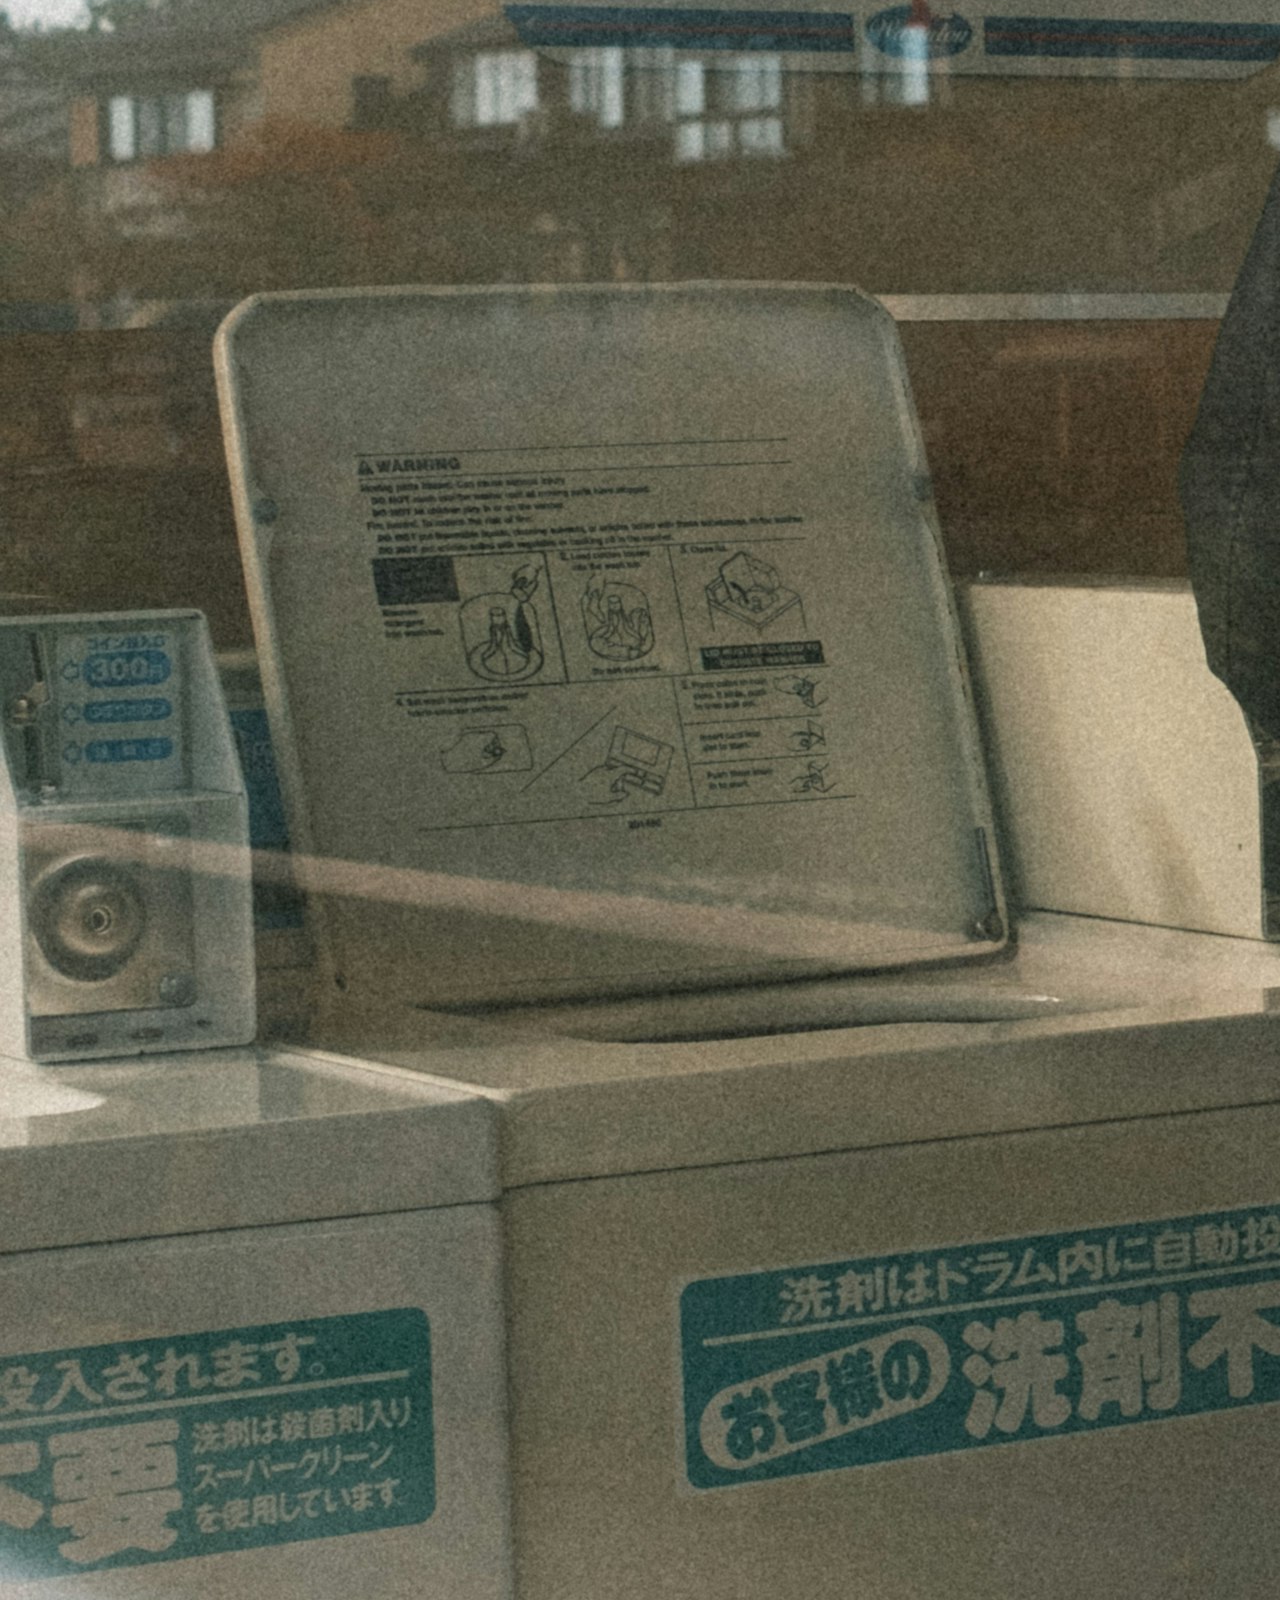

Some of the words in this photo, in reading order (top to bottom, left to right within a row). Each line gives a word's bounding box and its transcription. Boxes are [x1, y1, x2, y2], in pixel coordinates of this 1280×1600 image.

[375, 456, 461, 473] WARNING
[190, 1396, 412, 1454] 洗剤は殺菌剤入り
[721, 1337, 931, 1461] お客様の
[194, 1440, 395, 1492] スーパークリーン
